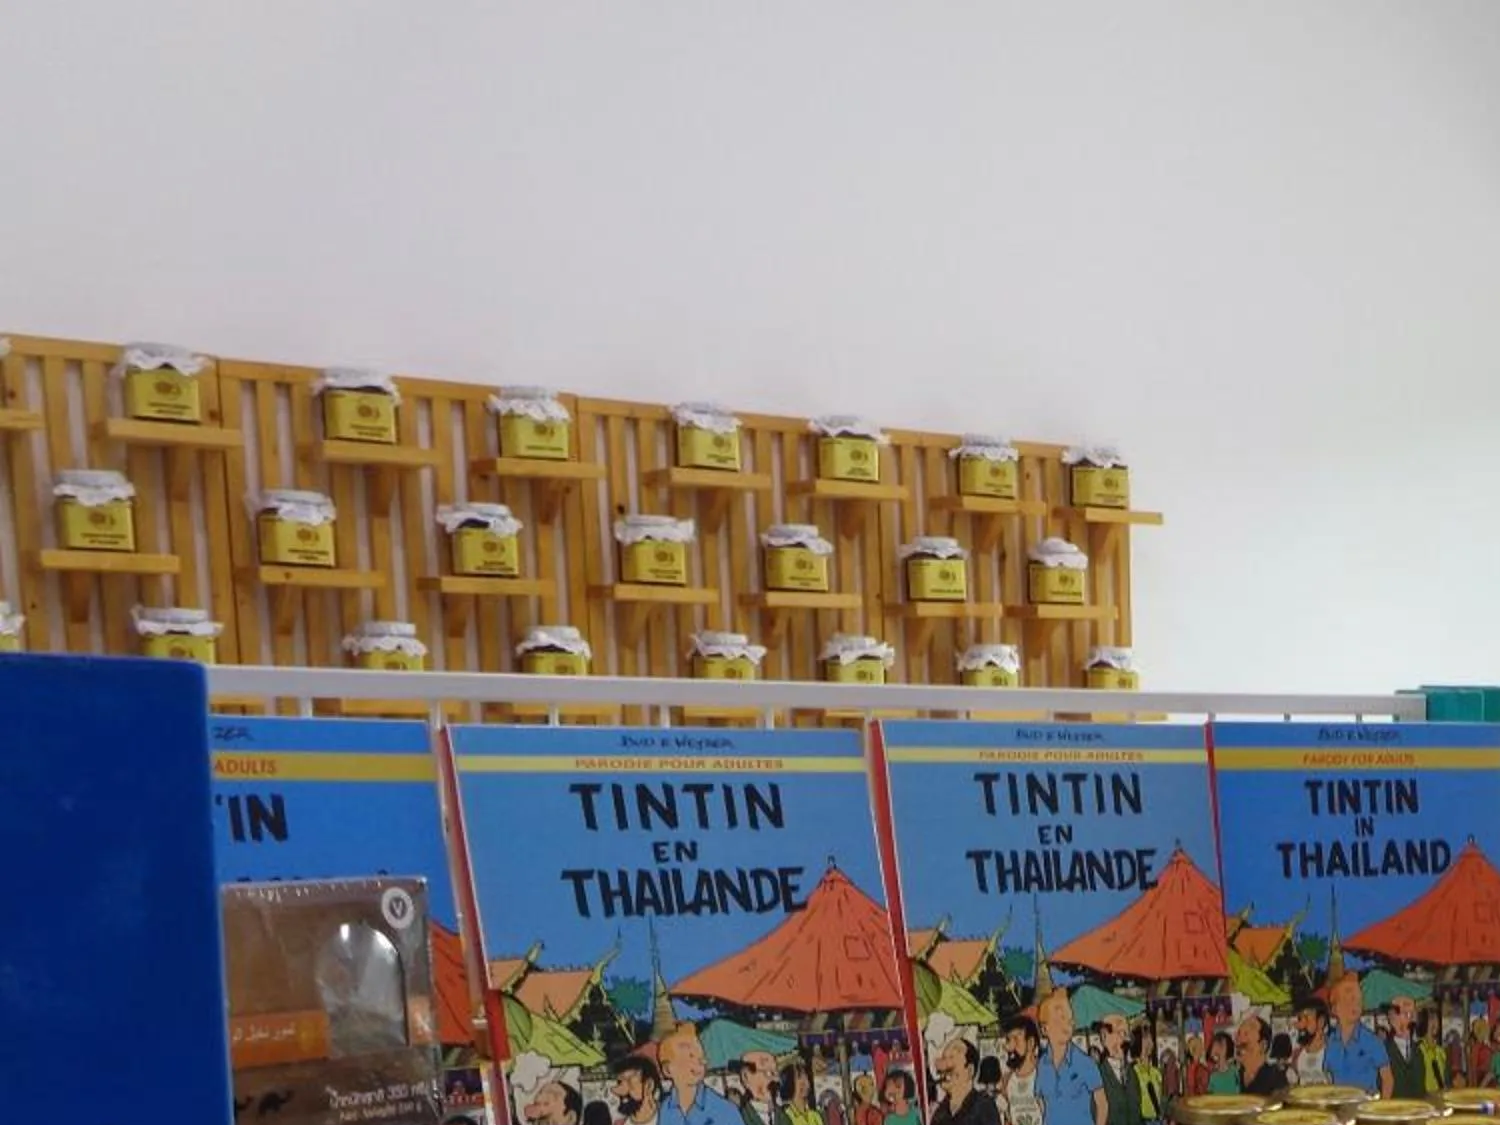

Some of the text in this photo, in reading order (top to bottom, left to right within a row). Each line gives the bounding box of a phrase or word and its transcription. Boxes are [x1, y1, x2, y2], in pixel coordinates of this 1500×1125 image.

[214, 758, 277, 775] ADULTS
[575, 758, 784, 769] PARODIE POUR ADULTES
[568, 781, 785, 832] TINTIN
[973, 771, 1143, 817] TINTIN
[1304, 777, 1419, 817] TINTIN
[215, 792, 289, 843] IN
[1354, 816, 1375, 838] IN
[1037, 824, 1073, 846] EN
[652, 840, 698, 864] EN
[1275, 838, 1452, 879] THAILAND
